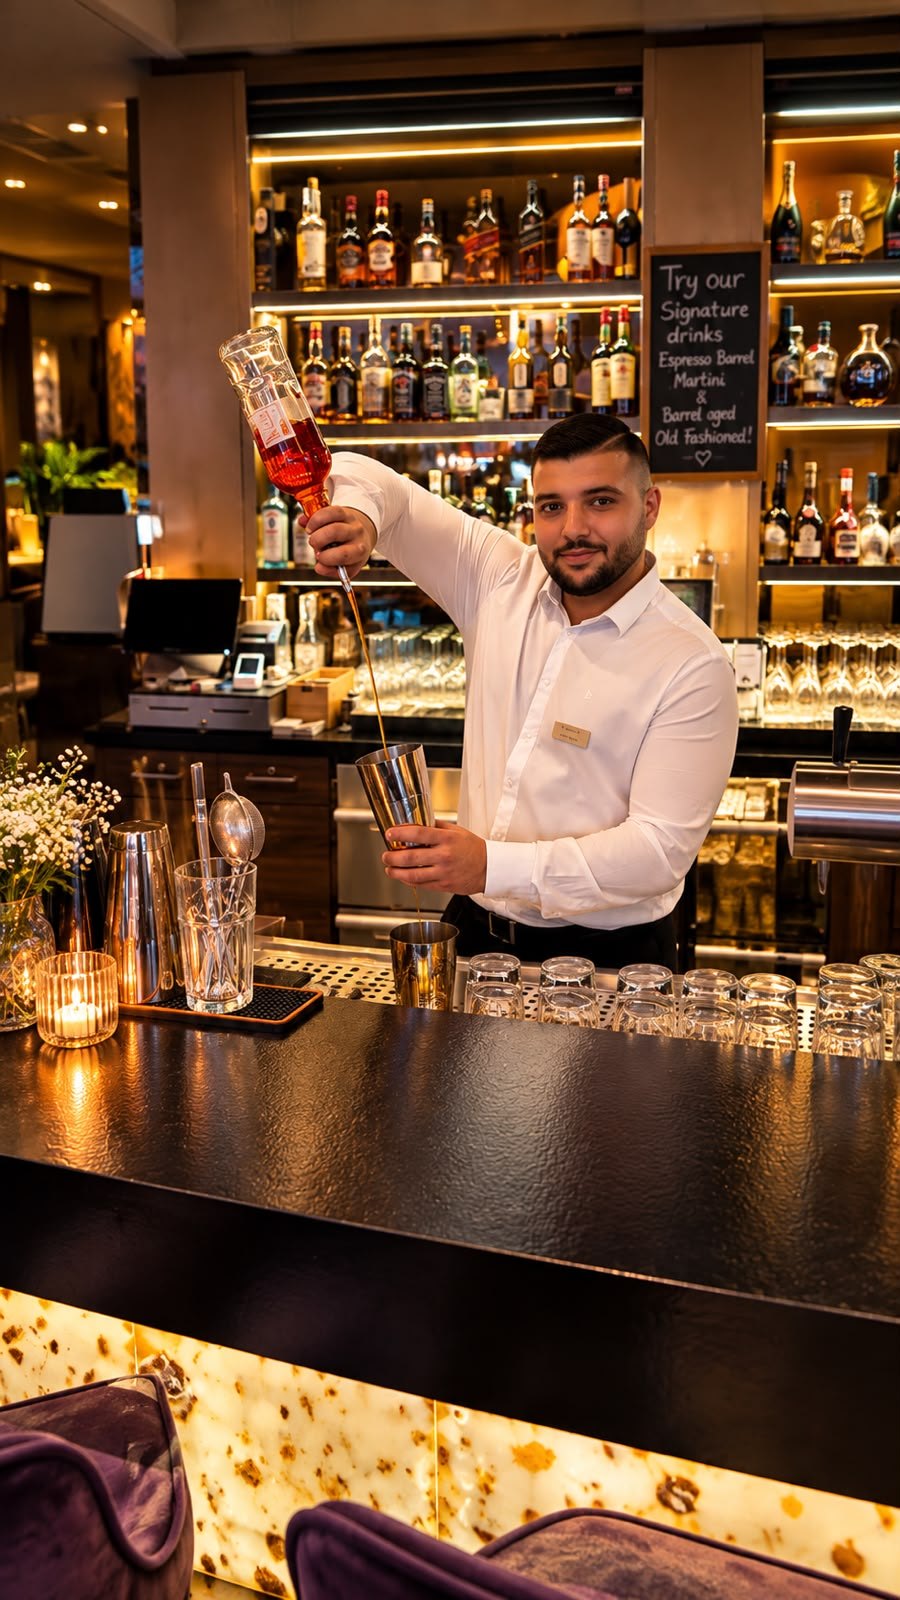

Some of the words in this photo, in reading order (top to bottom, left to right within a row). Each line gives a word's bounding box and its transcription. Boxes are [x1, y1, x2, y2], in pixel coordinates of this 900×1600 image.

[659, 264, 698, 299] Try
[706, 273, 744, 290] our
[660, 301, 749, 325] Signature
[667, 325, 723, 344] drinks
[659, 352, 712, 371] Espresso
[716, 349, 755, 365] Barrel
[673, 372, 726, 389] Martini
[696, 390, 707, 405] &
[662, 406, 702, 424] Barrel
[707, 405, 736, 427] aged
[655, 430, 679, 446] Old
[684, 426, 753, 445] Fashioned!
